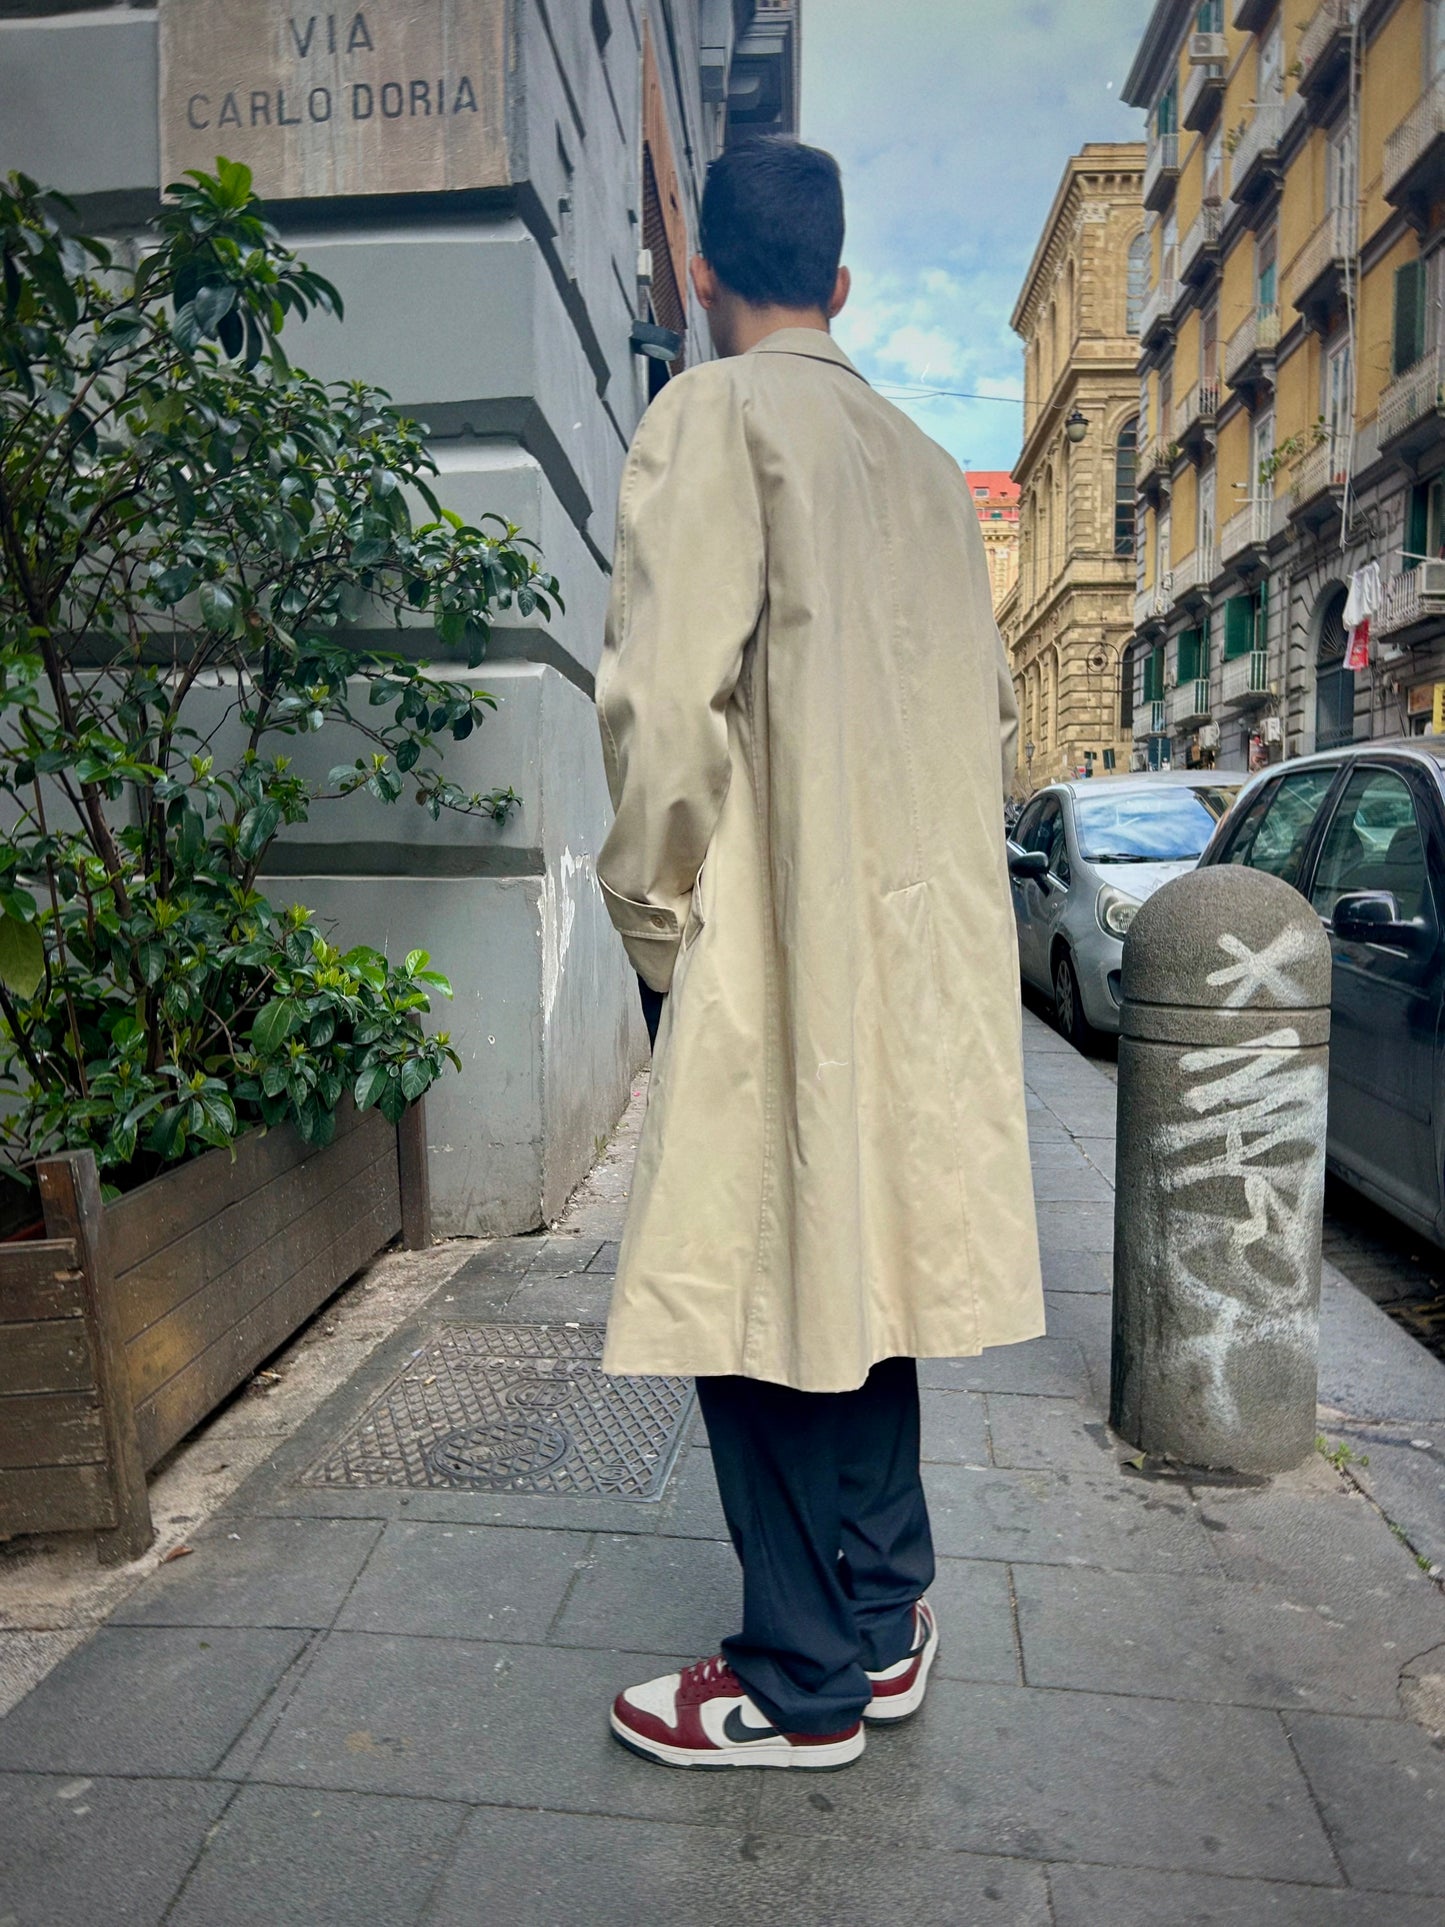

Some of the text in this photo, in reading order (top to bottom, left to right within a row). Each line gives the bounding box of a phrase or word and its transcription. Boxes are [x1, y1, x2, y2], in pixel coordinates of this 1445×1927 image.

[288, 12, 375, 58] VIA
[186, 75, 479, 130] CARLO DORIA
